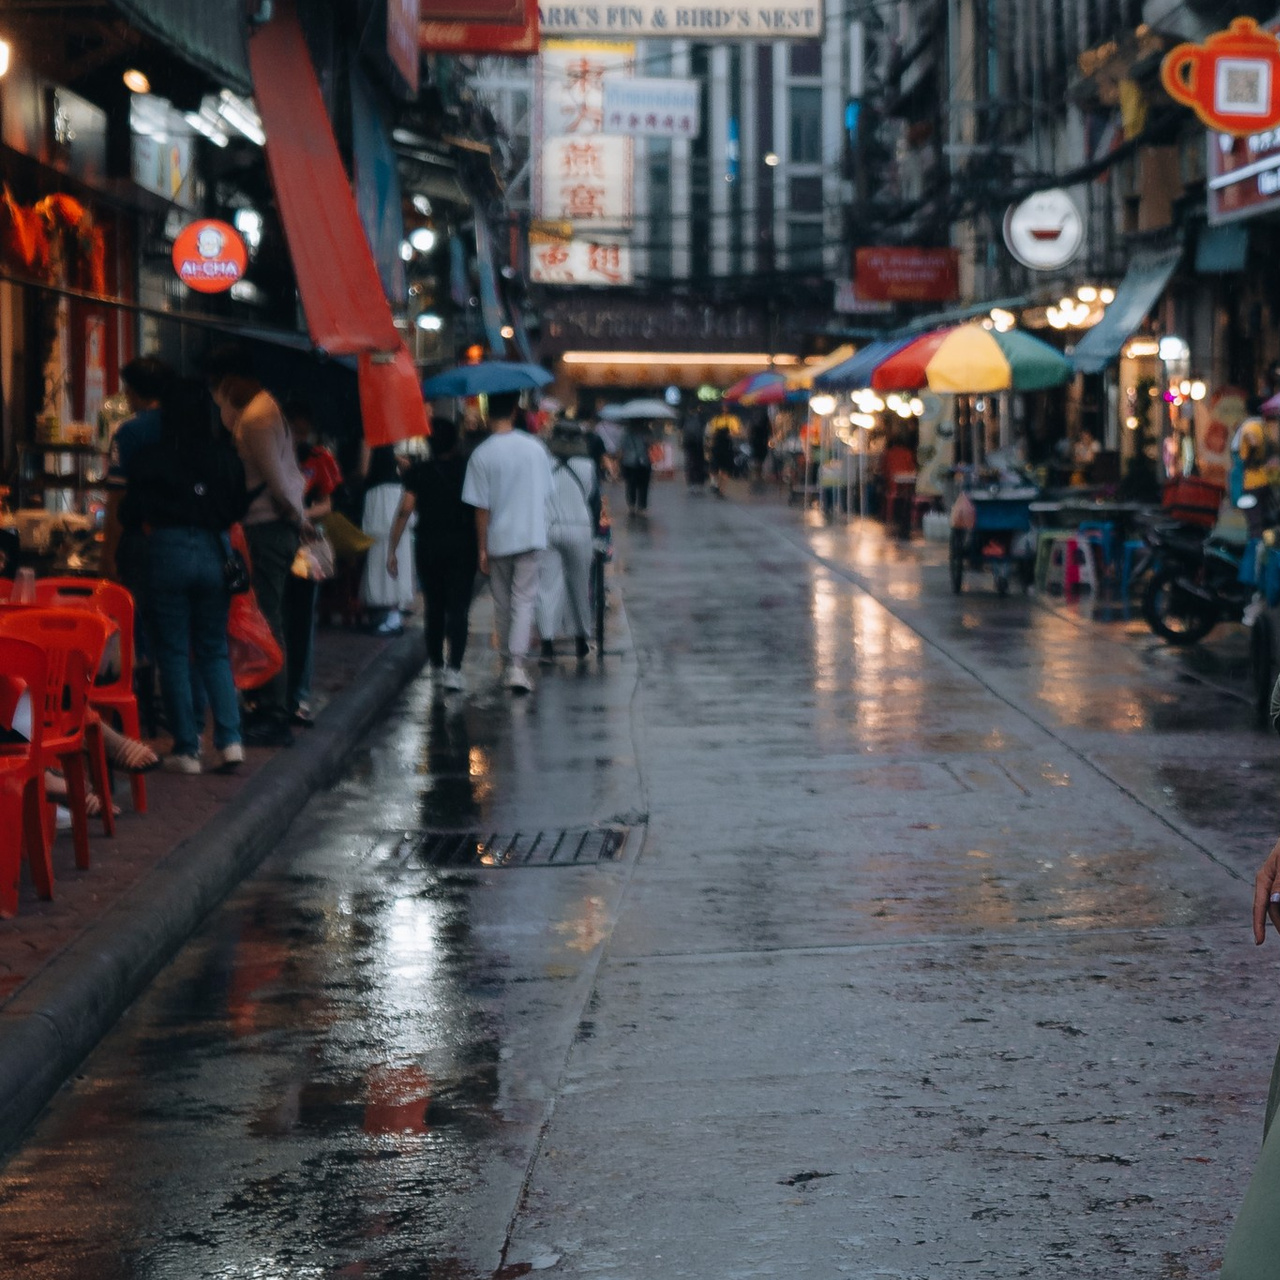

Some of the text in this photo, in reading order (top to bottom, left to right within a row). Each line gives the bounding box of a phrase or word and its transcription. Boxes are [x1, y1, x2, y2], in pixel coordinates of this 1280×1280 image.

[538, 6, 815, 29] ARK'S FIN & BIRD'S NEST
